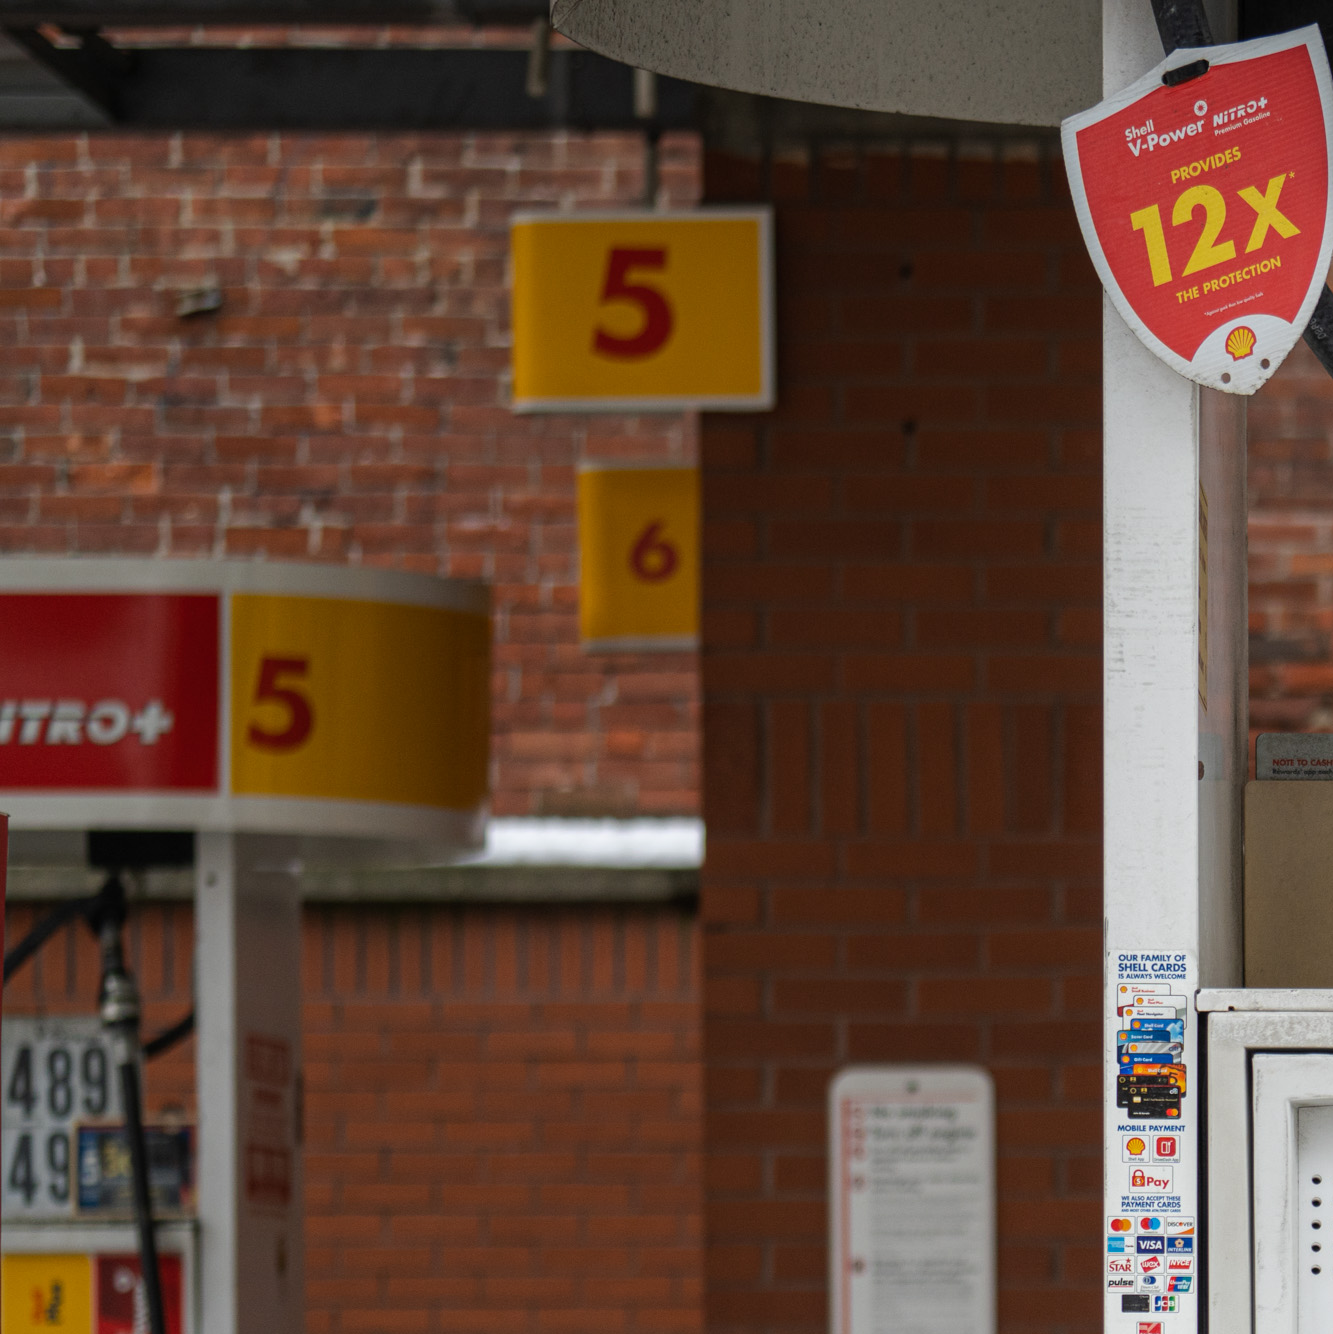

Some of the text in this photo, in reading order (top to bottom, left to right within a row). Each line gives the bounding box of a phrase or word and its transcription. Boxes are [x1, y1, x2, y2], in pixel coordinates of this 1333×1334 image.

[1125, 119, 1154, 141] Shell
[1171, 147, 1241, 184] PROVIDES
[1176, 256, 1282, 304] THE PROTECTION
[592, 245, 675, 360] 5
[628, 522, 678, 584] 6
[246, 655, 315, 754] 5
[1272, 759, 1294, 767] NOTE
[1297, 759, 1308, 767] TO
[1118, 963, 1186, 972] SHELL CARDS
[1147, 1177, 1169, 1189] Pay
[1138, 1240, 1162, 1249] VISA
[1108, 1278, 1134, 1287] pulse
